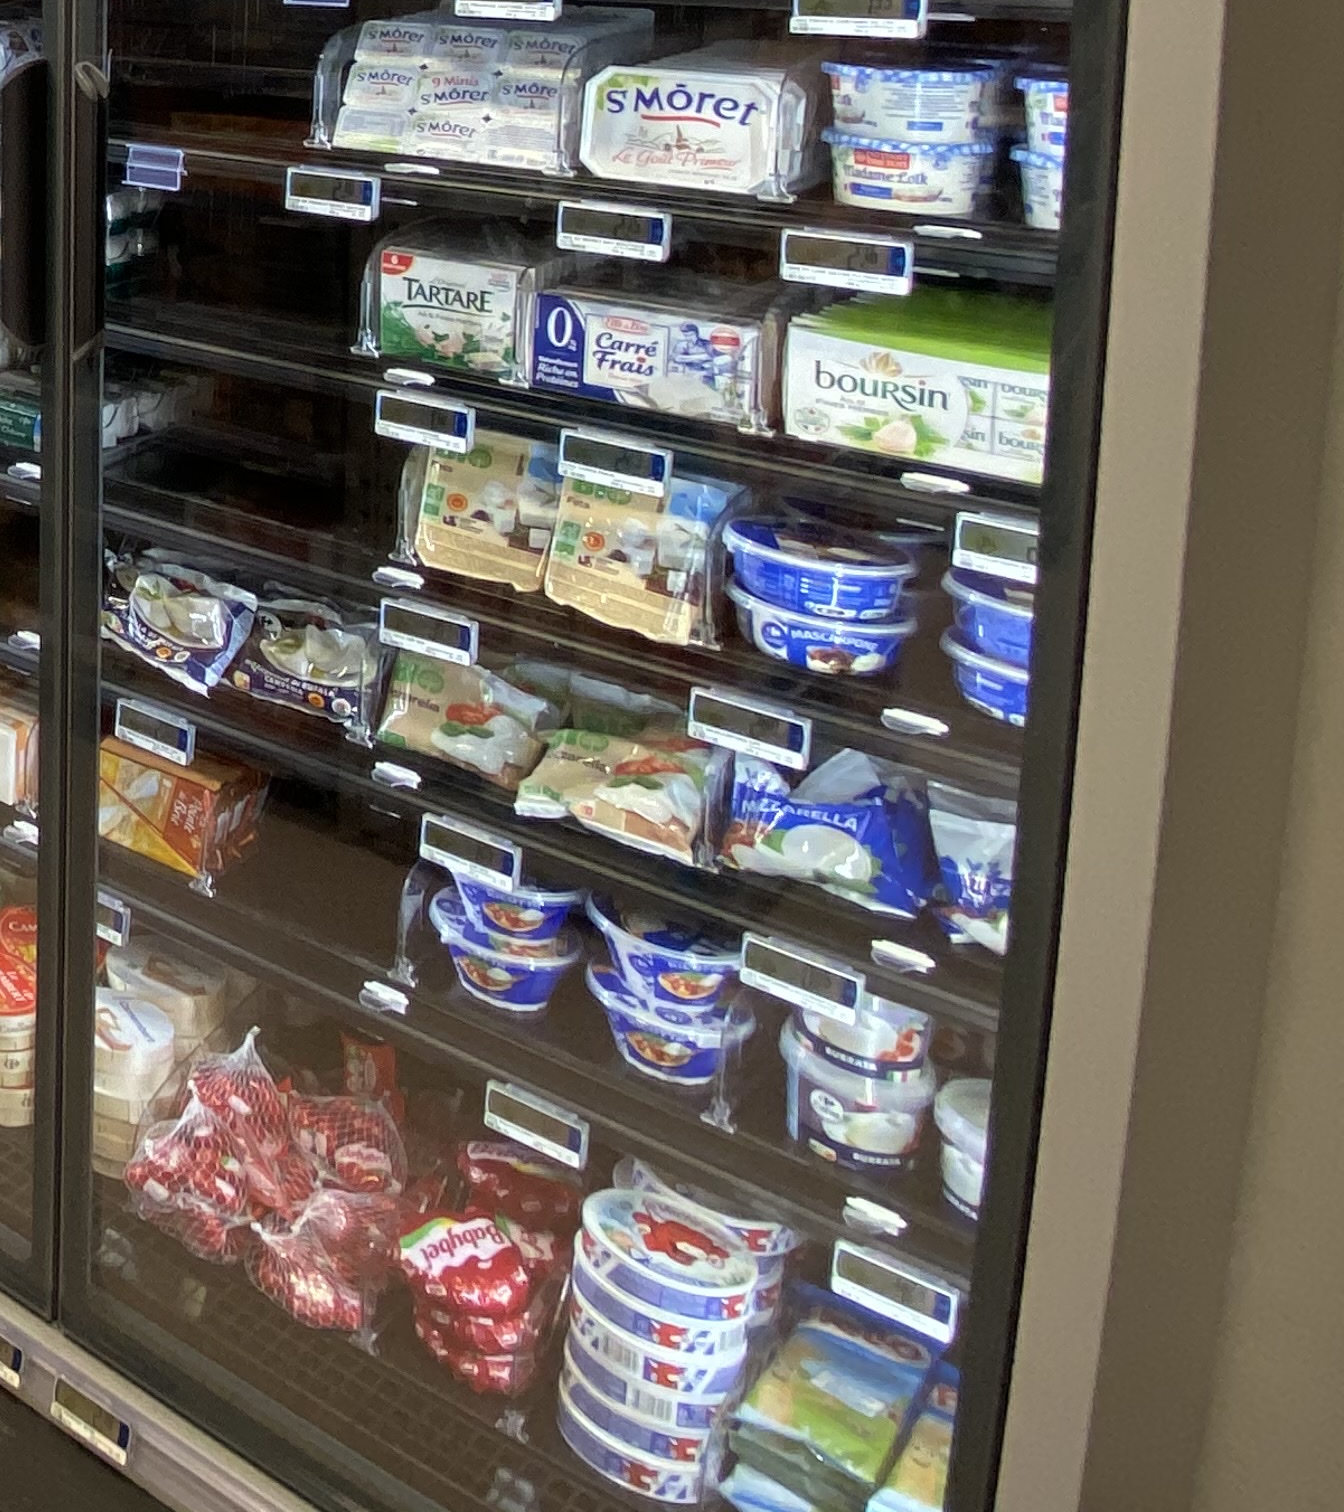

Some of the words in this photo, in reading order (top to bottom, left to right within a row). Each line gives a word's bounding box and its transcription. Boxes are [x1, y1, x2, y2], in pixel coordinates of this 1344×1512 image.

[402, 276, 495, 314] TARTARE
[592, 349, 657, 376] Frais
[595, 331, 659, 357] Carré
[814, 359, 949, 412] boursin
[420, 1220, 506, 1261] Babybel
